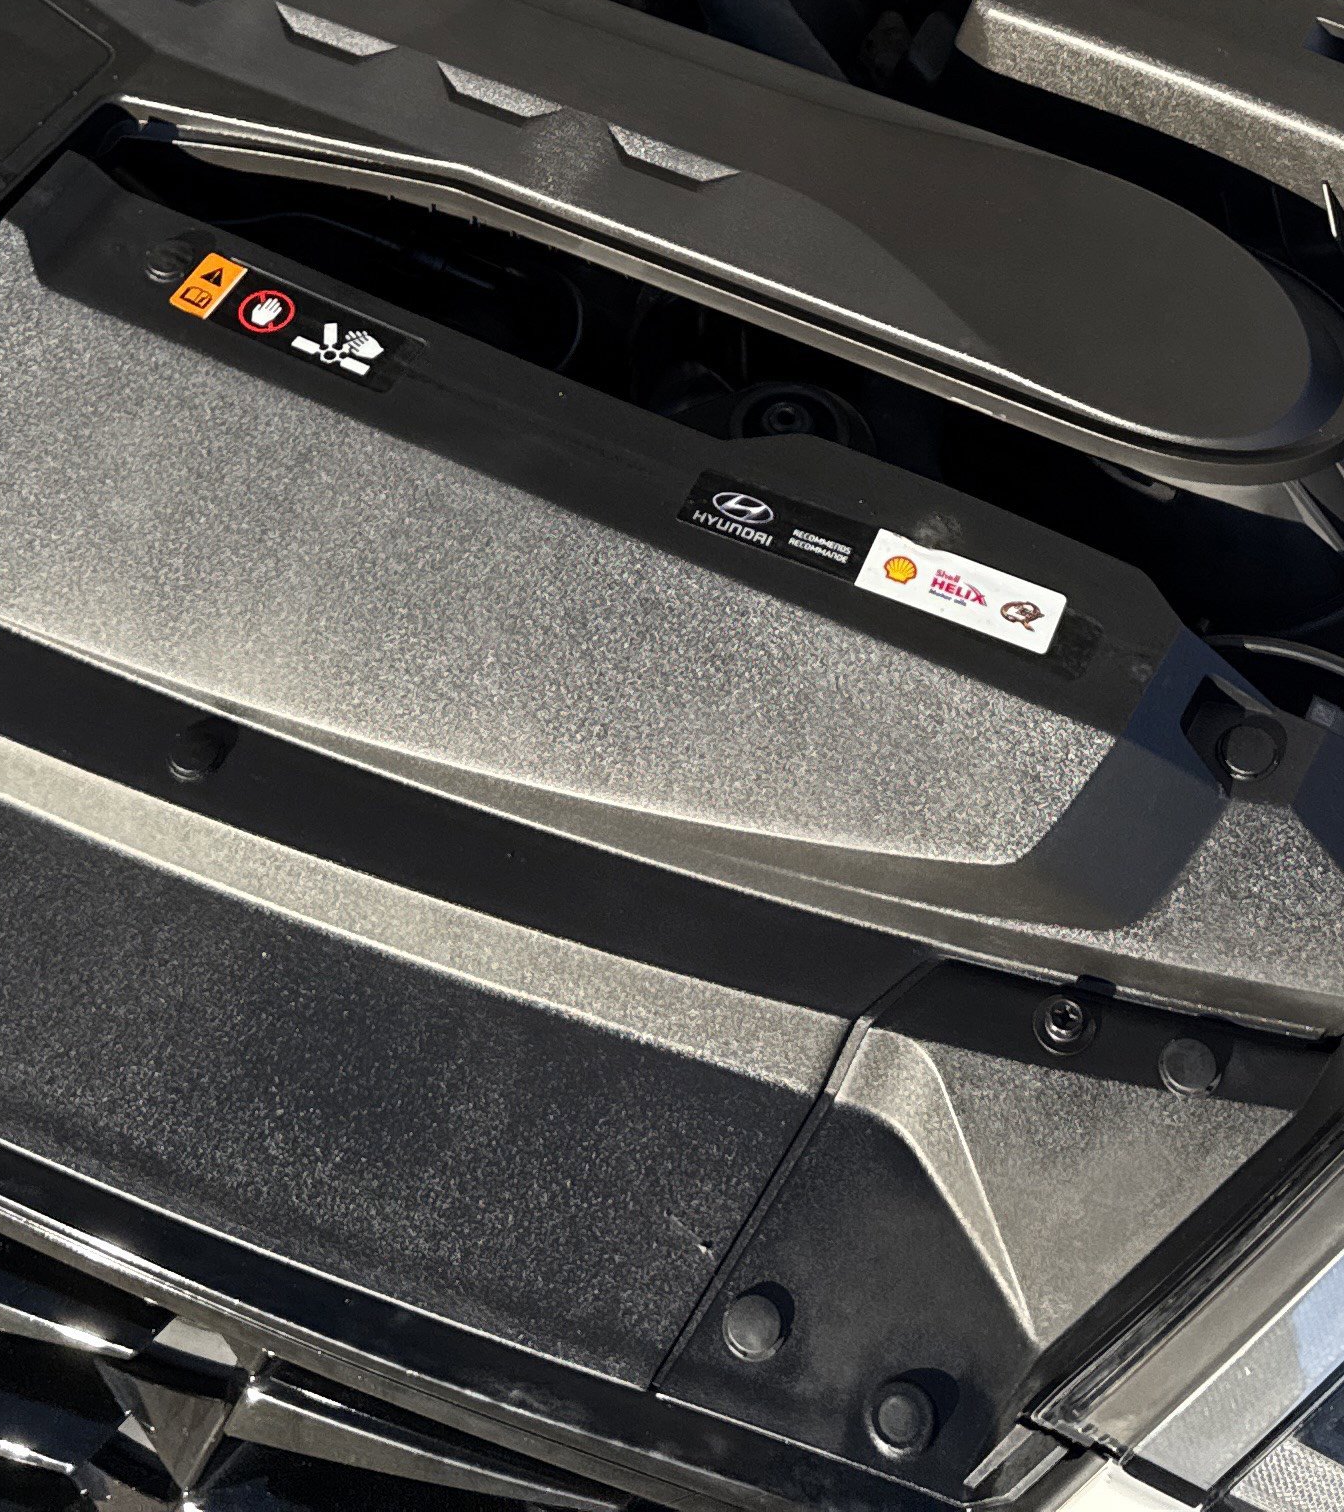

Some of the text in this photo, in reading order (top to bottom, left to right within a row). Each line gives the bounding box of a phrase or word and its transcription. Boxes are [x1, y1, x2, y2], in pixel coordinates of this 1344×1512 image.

[692, 510, 774, 546] HYUNDAI
[793, 528, 852, 555] RECOMMENDS
[788, 537, 849, 564] RECOMMANDE
[935, 569, 961, 583] Shell
[930, 577, 987, 607] HELIX
